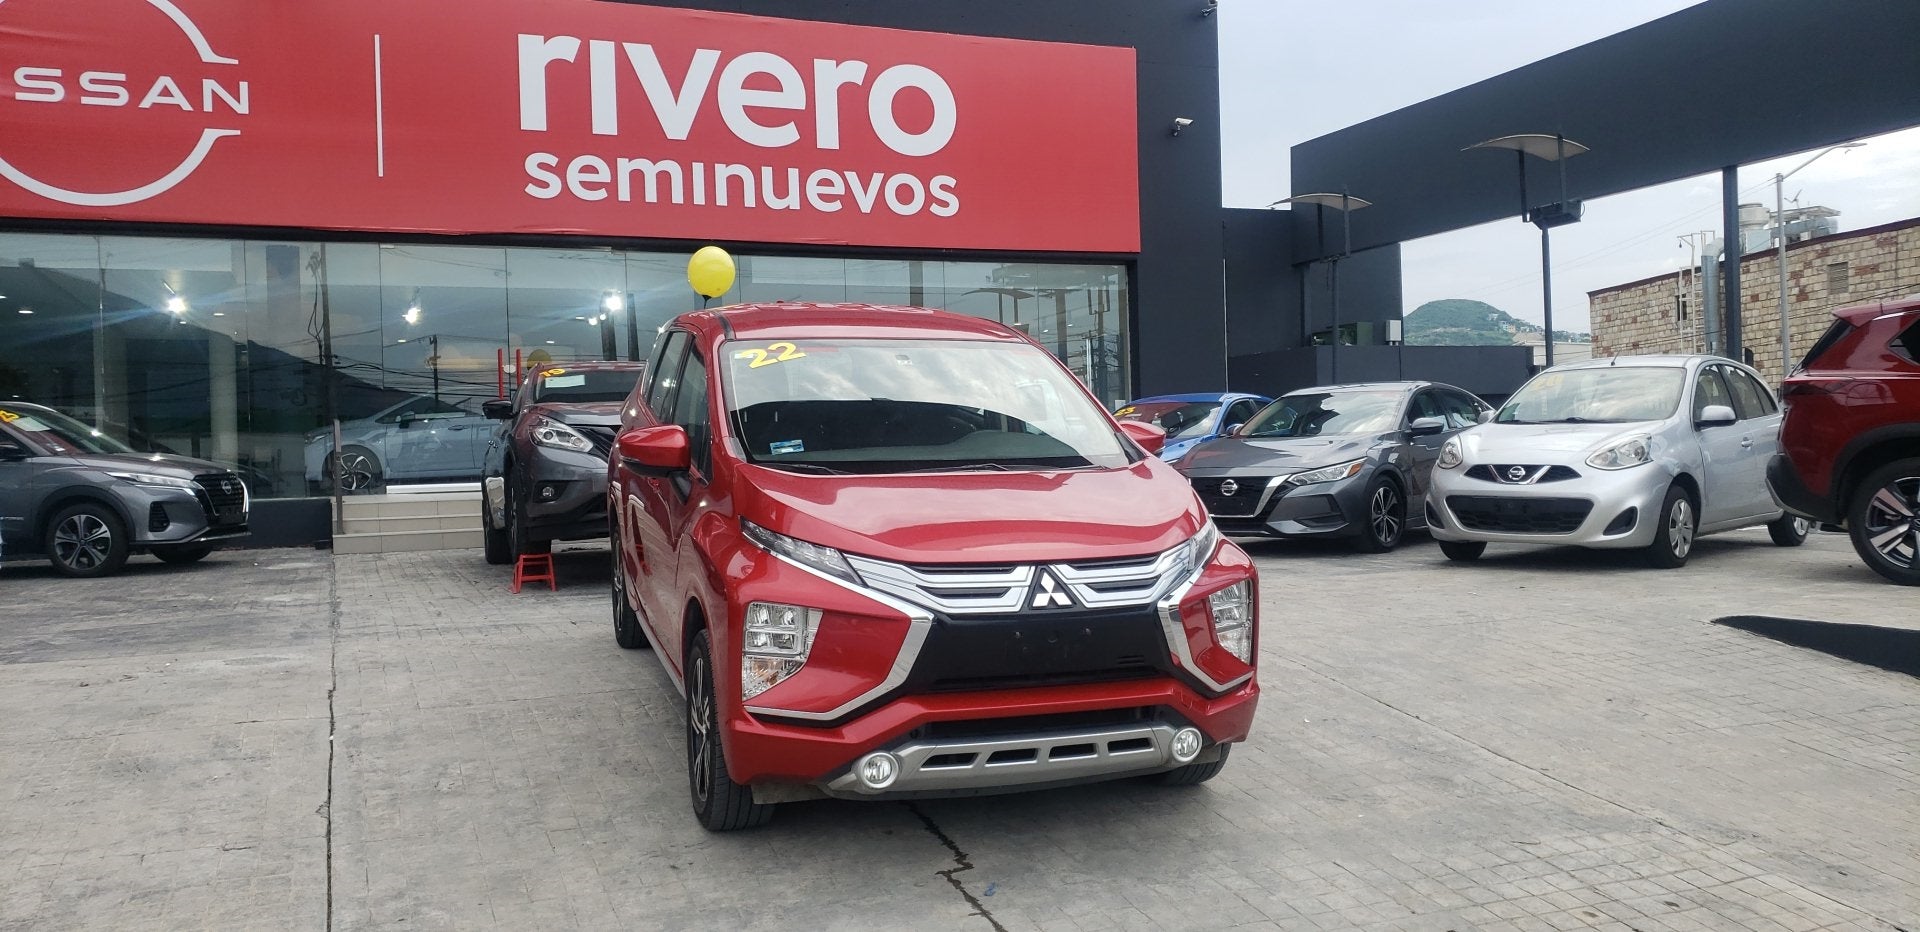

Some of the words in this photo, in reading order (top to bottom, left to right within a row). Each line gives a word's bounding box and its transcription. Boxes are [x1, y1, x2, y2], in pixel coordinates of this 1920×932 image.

[518, 33, 956, 157] rivero
[524, 152, 959, 217] seminuevos
[740, 342, 807, 369] 22
